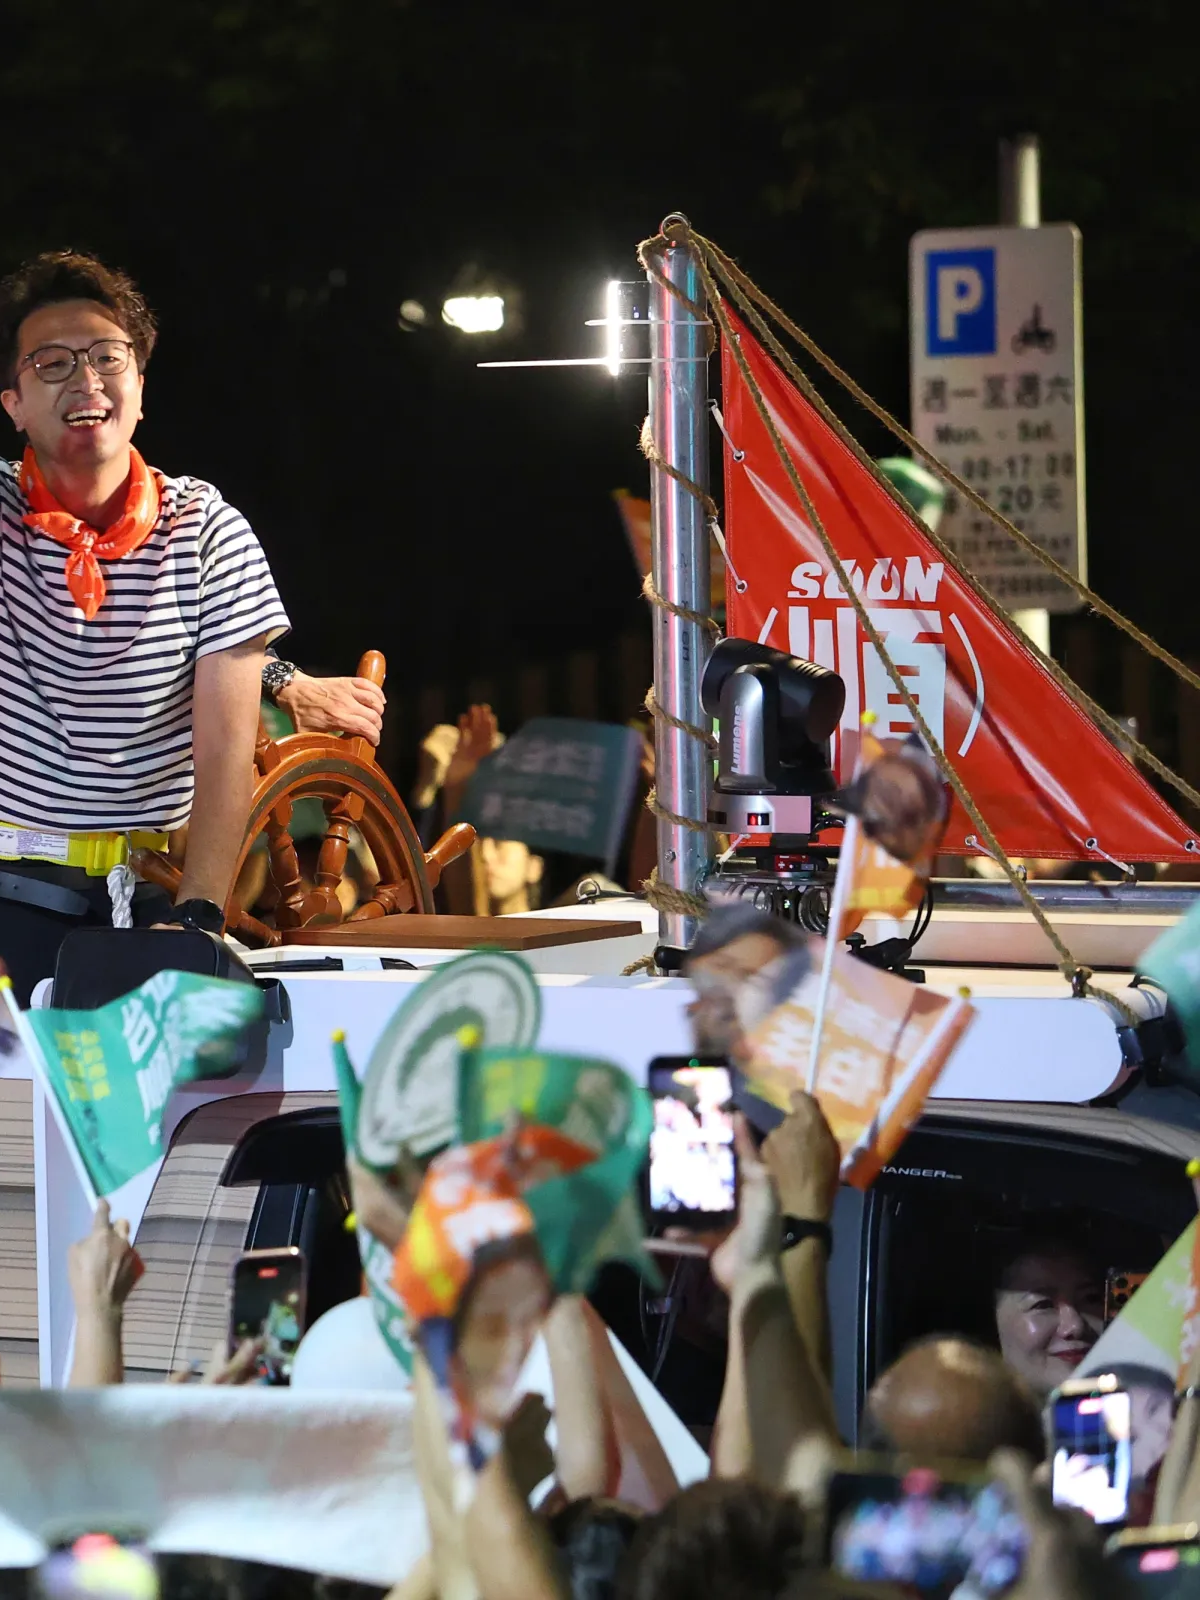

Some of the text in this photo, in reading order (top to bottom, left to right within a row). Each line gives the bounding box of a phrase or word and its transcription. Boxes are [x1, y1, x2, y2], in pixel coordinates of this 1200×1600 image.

[936, 266, 984, 341] P
[787, 556, 945, 602] SOON
[731, 705, 744, 774] Lumens
